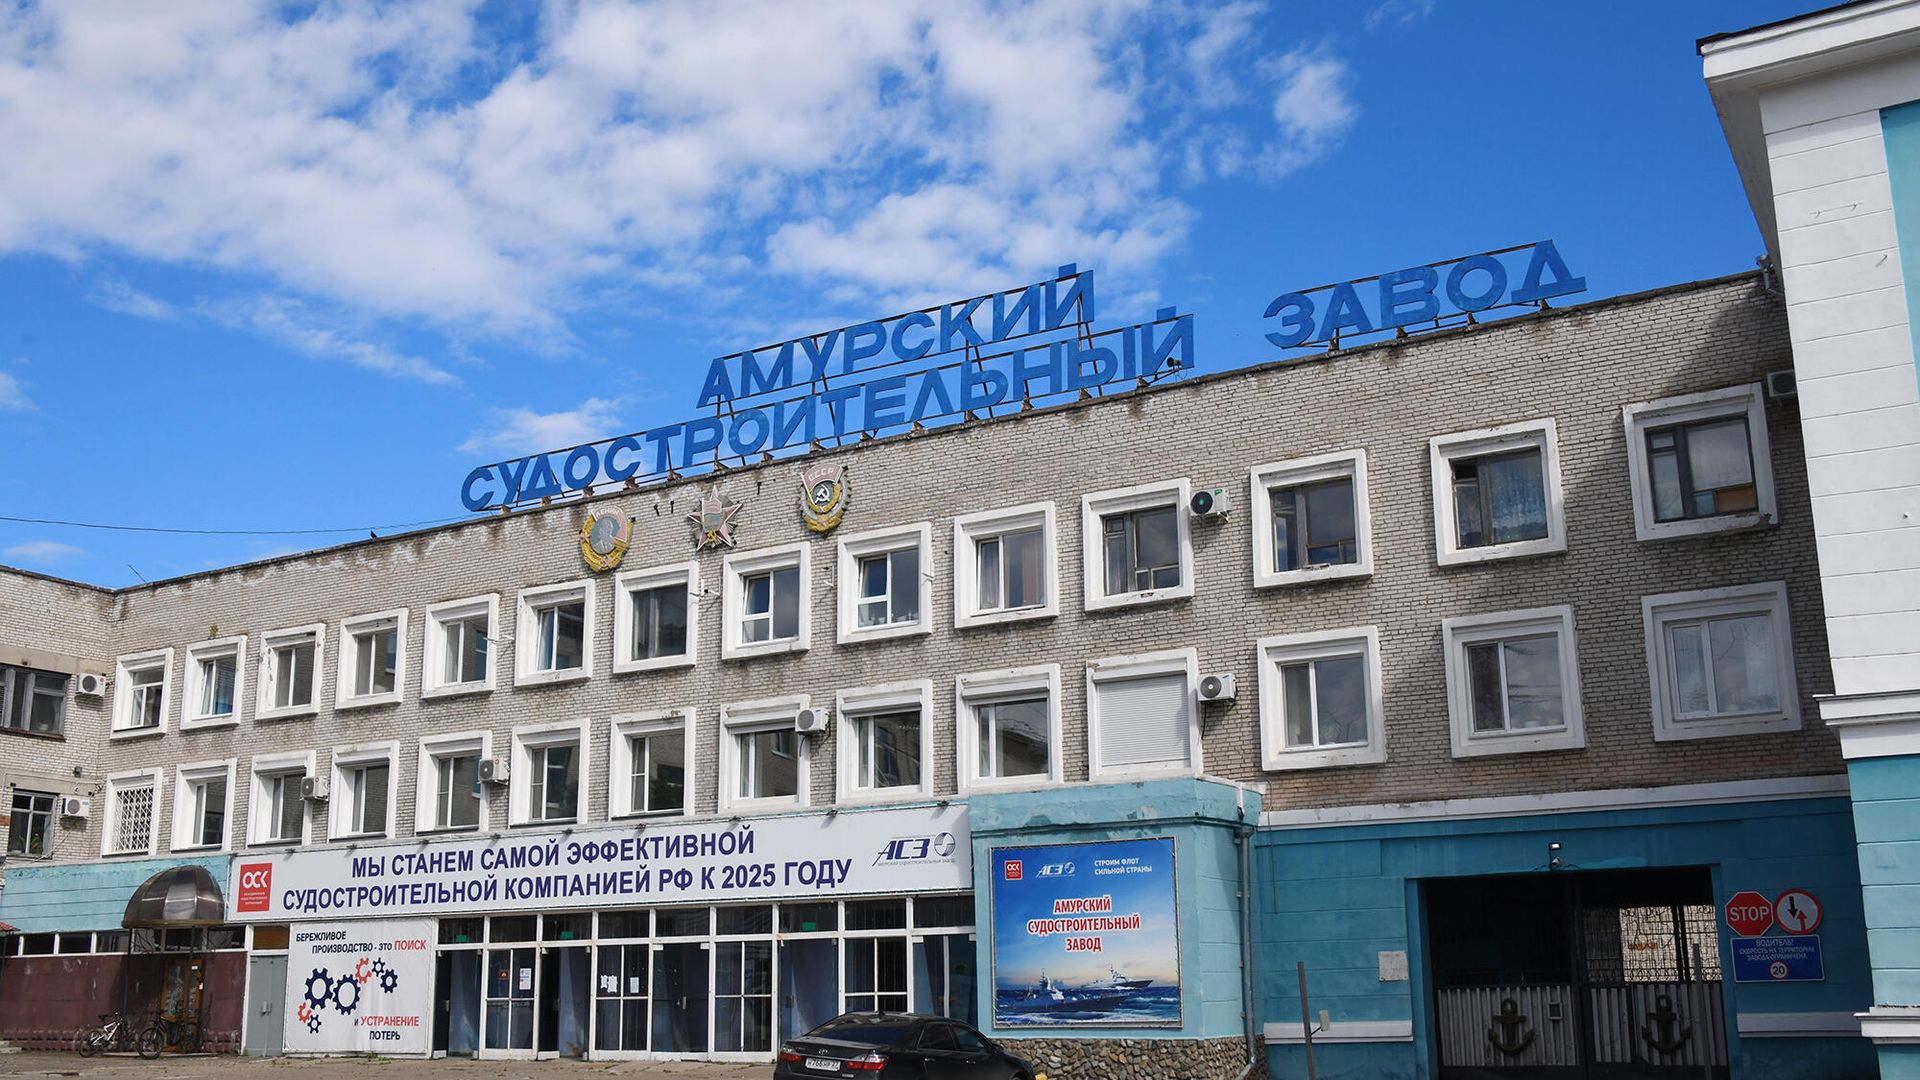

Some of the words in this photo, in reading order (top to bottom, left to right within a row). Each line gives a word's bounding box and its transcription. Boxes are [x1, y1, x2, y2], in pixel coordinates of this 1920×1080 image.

[696, 263, 1094, 408] АМУРСКИЙ
[460, 306, 1194, 511] СУДОСТРОИТЕЛЬНЫЙ
[1264, 239, 1587, 348] ЗАВОД
[808, 467, 834, 482] СССР
[352, 856, 385, 878] МЫ
[391, 850, 473, 875] СТАНЕМ
[480, 838, 559, 869] САМОЙ
[567, 824, 754, 864] ЭФФЕКТИВНОЙ
[872, 839, 931, 867] АСЗ
[1094, 859, 1120, 867] СТРОИМ
[1121, 857, 1140, 865] ФЛОТ
[1094, 865, 1125, 876] СИЛЬНОЙ
[1126, 865, 1153, 874] СТРАНЫ
[242, 870, 268, 888] ОСК
[283, 874, 497, 912] СУДОСТРОИТЕЛЬНОЙ
[505, 864, 650, 899] КОМПАНИЕЙ
[658, 868, 693, 892] РФ
[701, 866, 715, 890] К
[721, 863, 776, 889] 2025
[784, 858, 853, 889] ГОДУ
[1054, 896, 1111, 913] АМУРСКИЙ
[1729, 905, 1769, 921] STOP
[1027, 914, 1140, 935] СУДОСТРОИТЕЛЬНЫЙ
[296, 931, 346, 942] БЕРЕЖЛИВОЕ
[312, 942, 373, 954] ПРОИЗВОДСТВО
[394, 939, 427, 951] ПОИСК
[1066, 937, 1102, 952] ЗАВОД
[1772, 965, 1786, 976] 20
[360, 1016, 420, 1027] УСТРАНЕНИЕ
[369, 1030, 401, 1041] ПОТЕРЬ
